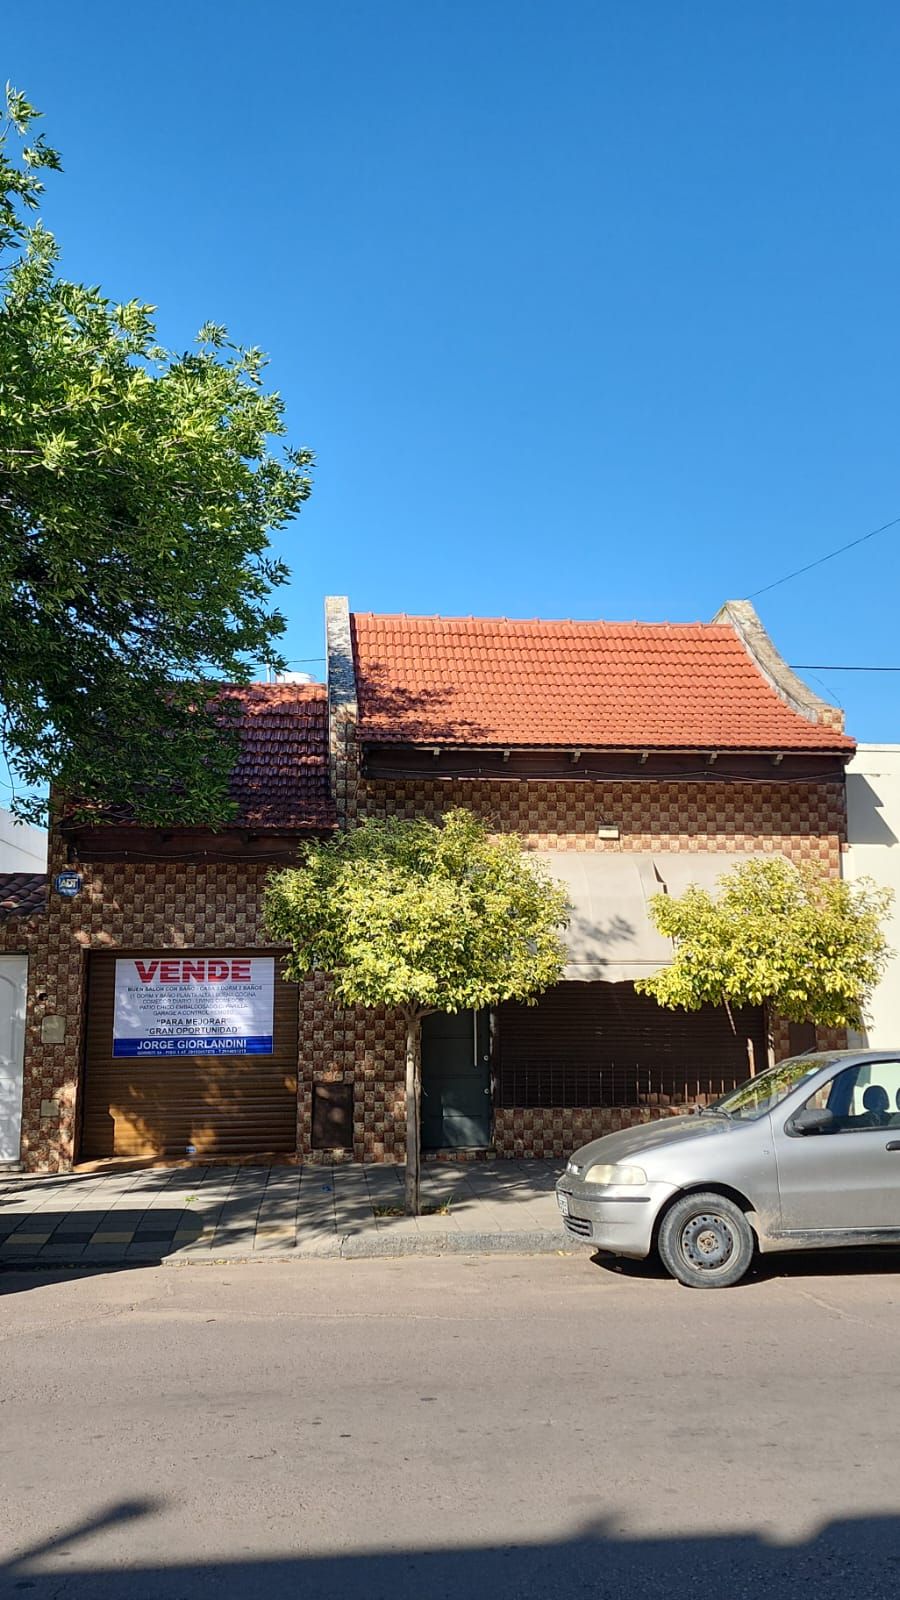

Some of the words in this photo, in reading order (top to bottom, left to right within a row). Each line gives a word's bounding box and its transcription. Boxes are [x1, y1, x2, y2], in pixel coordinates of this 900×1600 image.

[60, 878, 78, 888] ADT
[134, 960, 251, 983] VENDE
[137, 1040, 174, 1050] JORGE
[177, 1039, 246, 1049] GIORLANDINI
